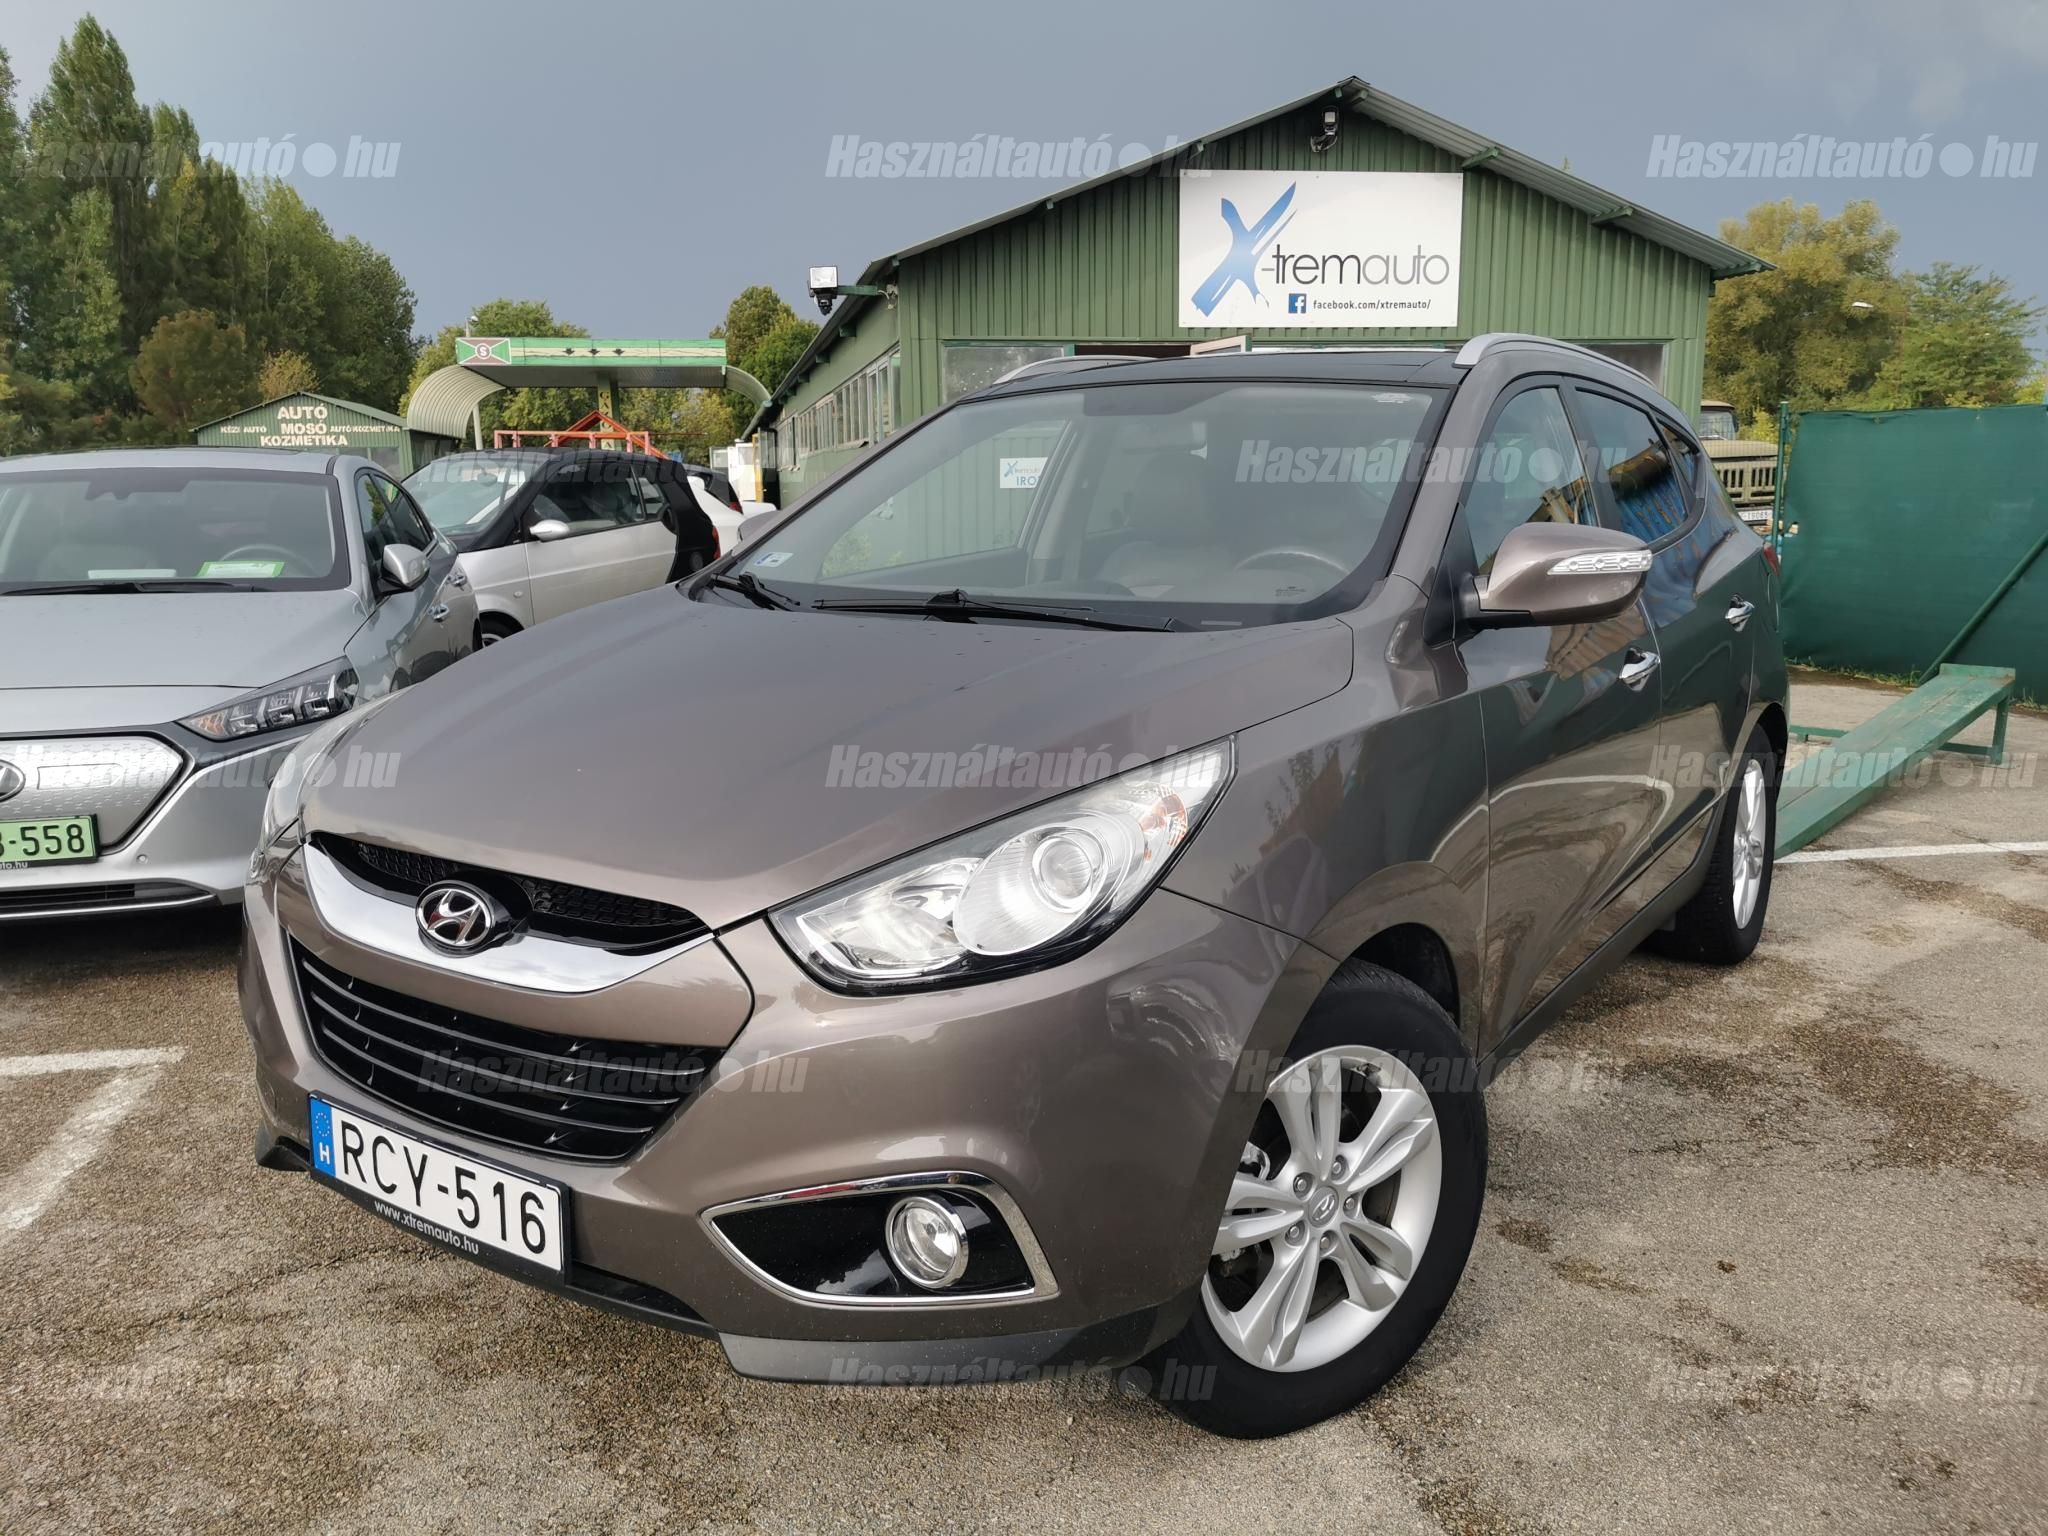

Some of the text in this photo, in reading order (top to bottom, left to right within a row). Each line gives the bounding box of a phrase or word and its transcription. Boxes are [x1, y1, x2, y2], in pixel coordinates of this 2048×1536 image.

[1313, 299, 1431, 310] facebook.com/xtremauto/
[277, 403, 328, 419] AUTÓ
[243, 424, 267, 433] AUTÓ
[281, 419, 327, 434] MOSÓ
[330, 424, 350, 433] AUTÓ
[260, 435, 348, 446] KOZMETIKA
[1015, 475, 1041, 487] IRO
[0, 823, 85, 857] -558
[319, 1142, 331, 1165] H
[341, 1119, 547, 1255] RCY-516
[374, 1200, 480, 1255] www.xtremauto.hu
